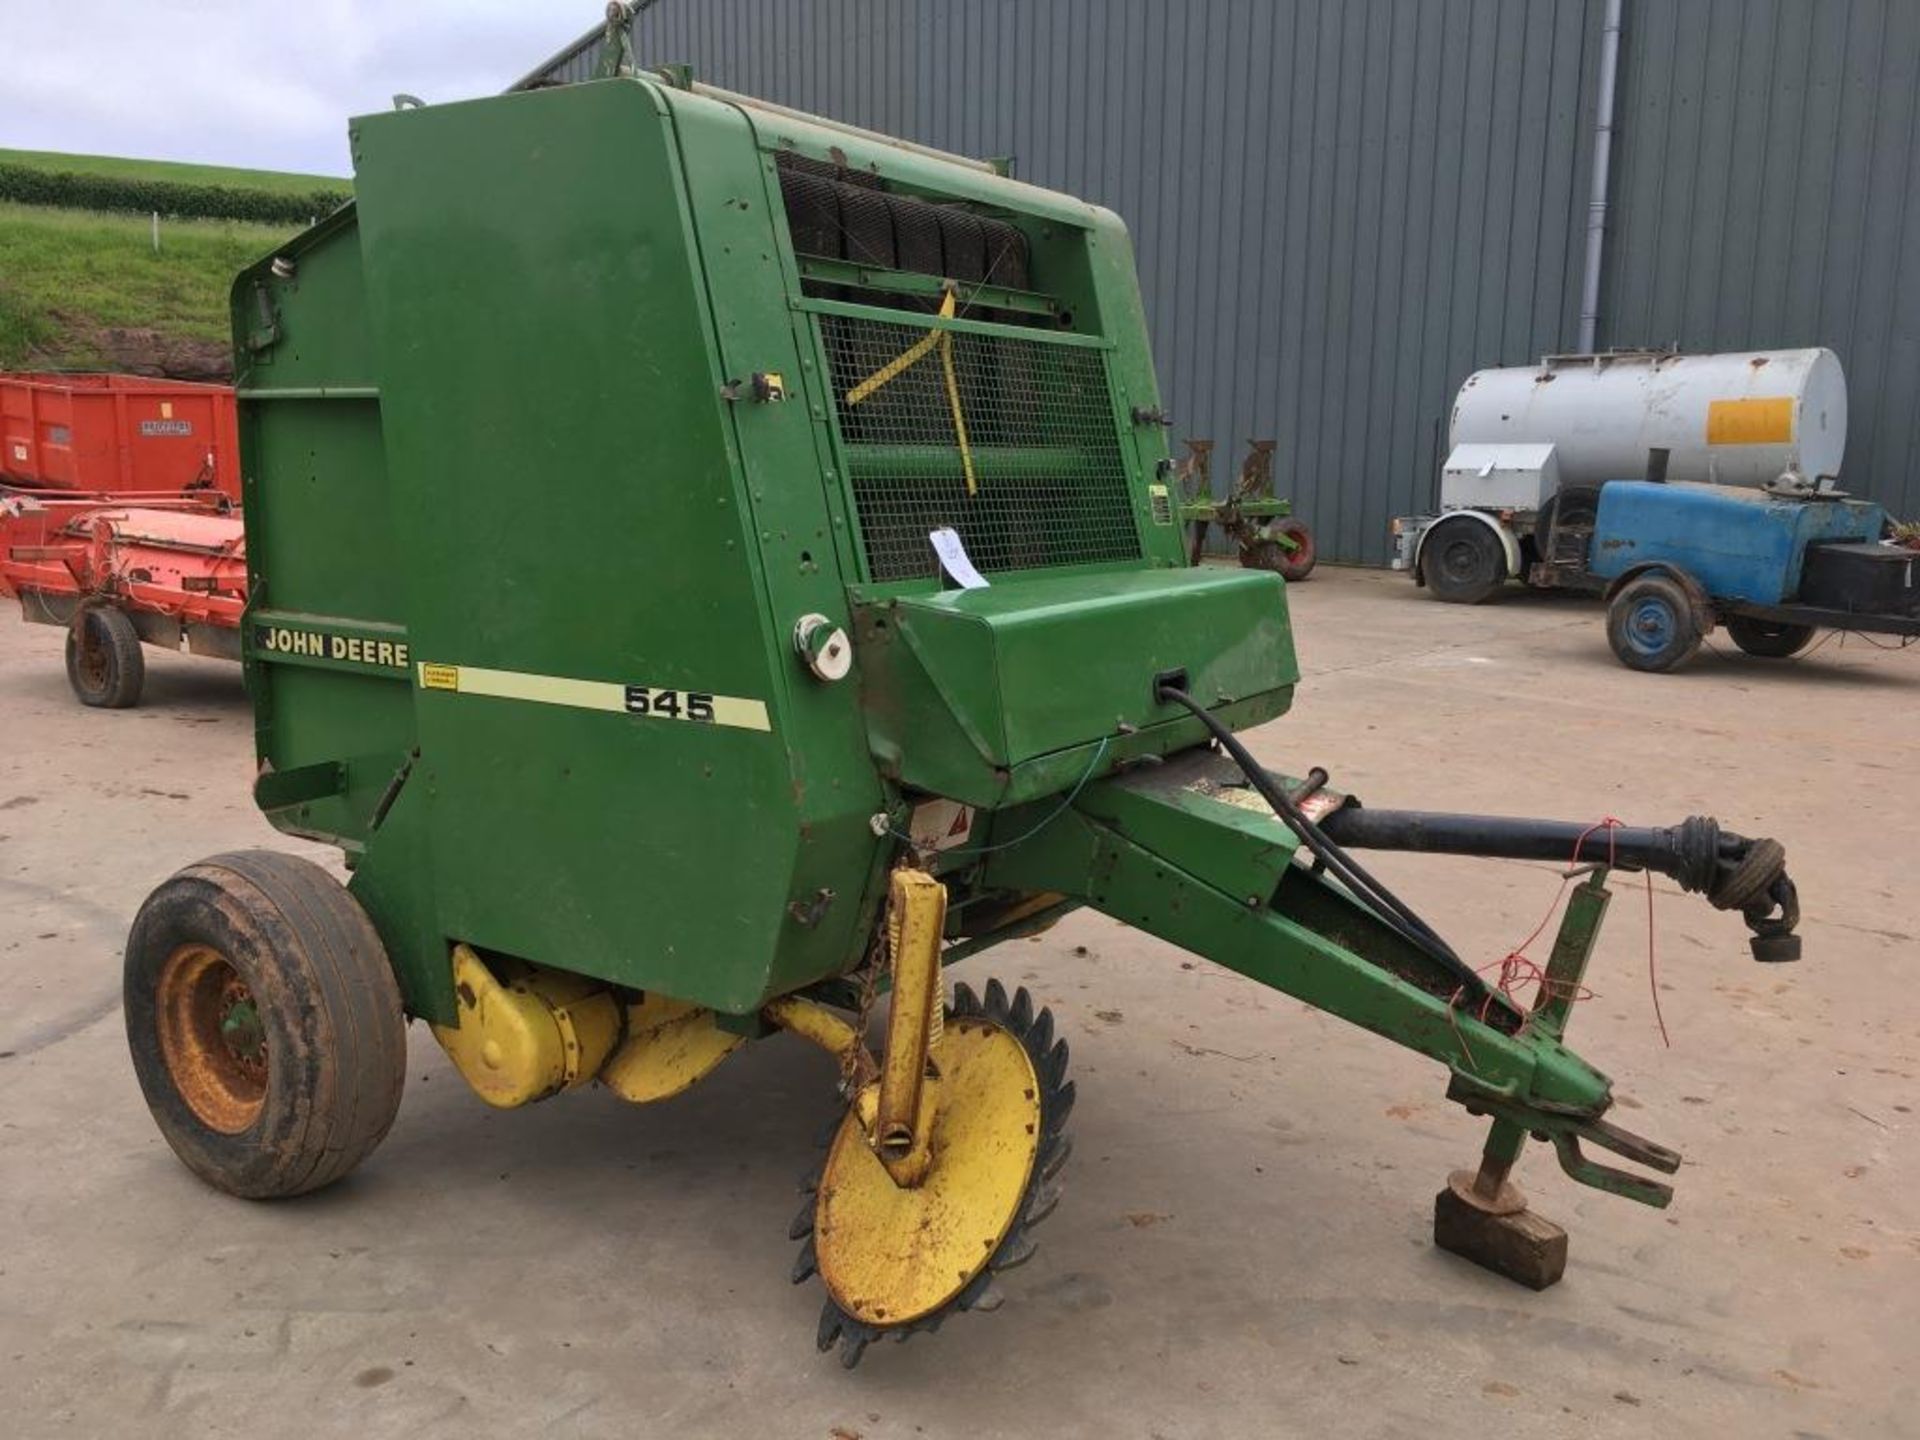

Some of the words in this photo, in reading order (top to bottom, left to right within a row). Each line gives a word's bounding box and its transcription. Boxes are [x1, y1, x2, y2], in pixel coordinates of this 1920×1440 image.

[265, 627, 323, 657] JOHN
[331, 636, 408, 667] DEERE
[624, 686, 714, 721] 545
